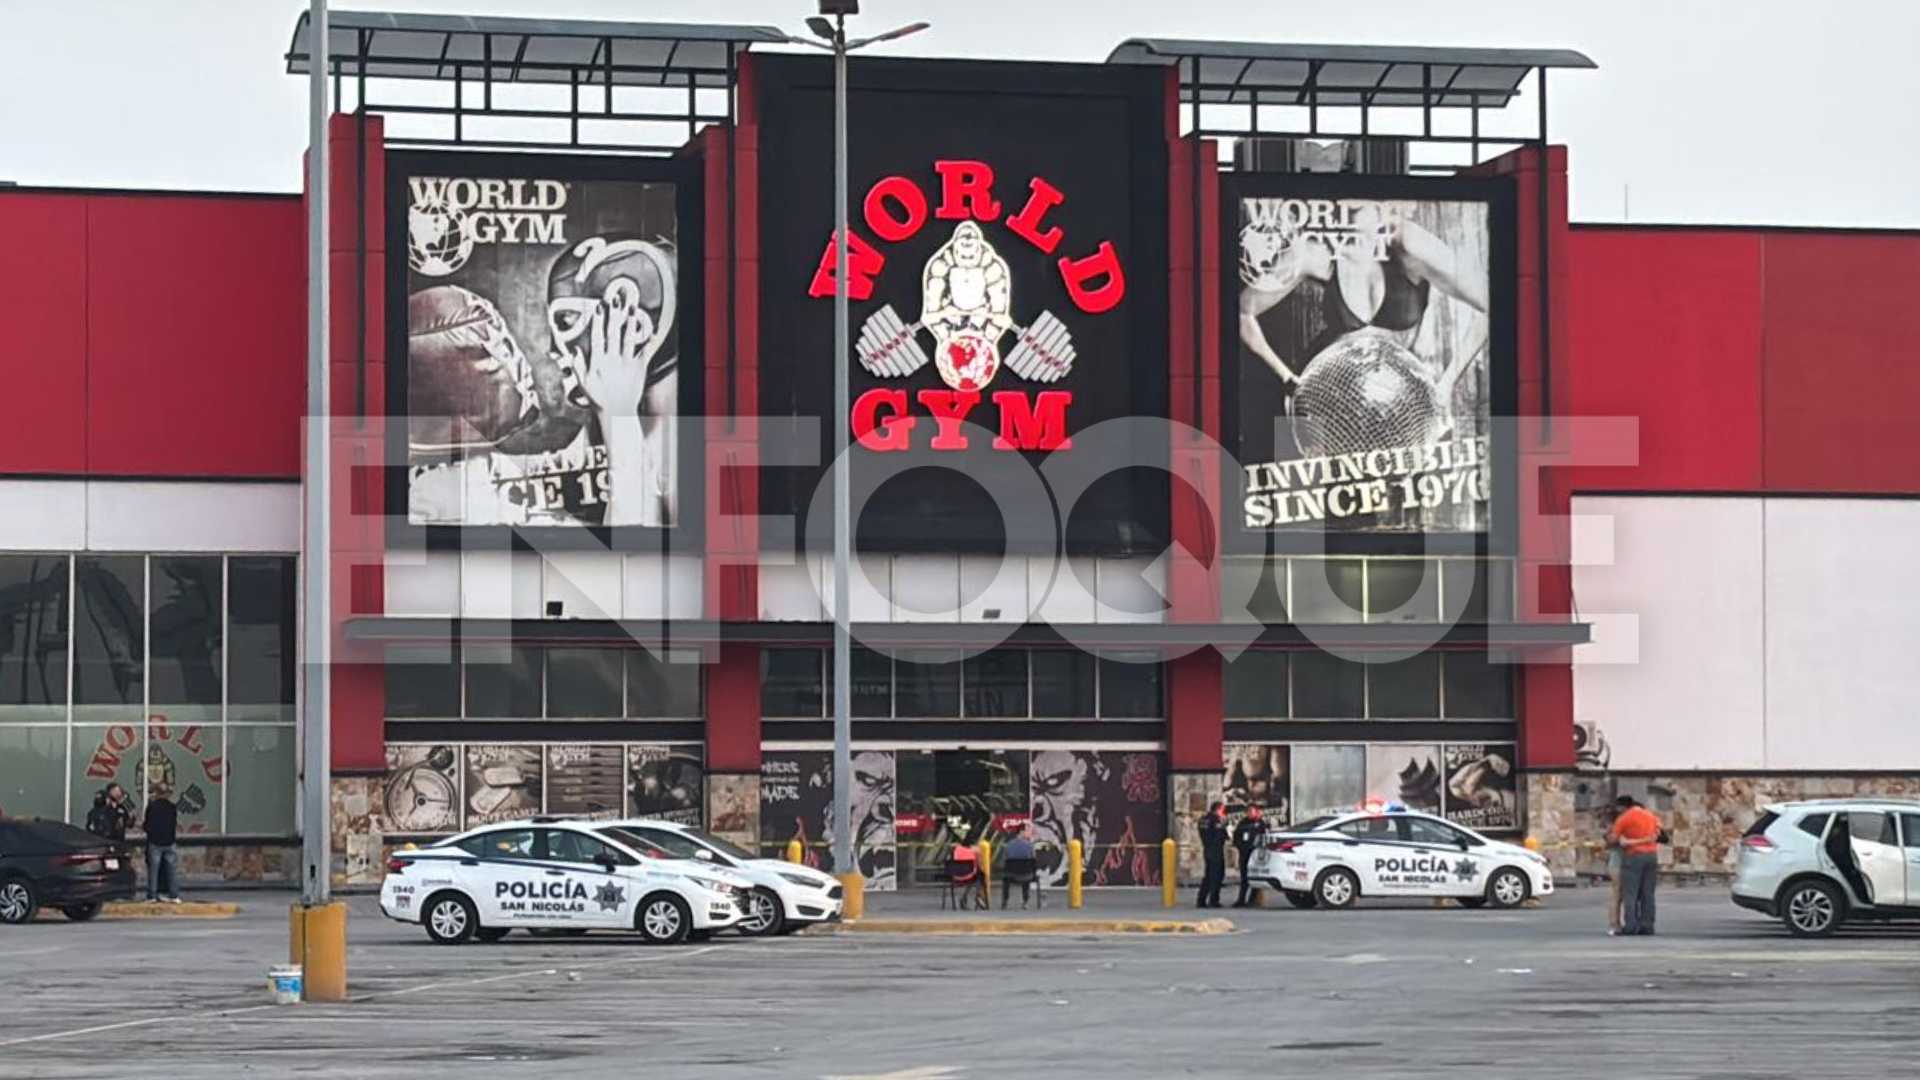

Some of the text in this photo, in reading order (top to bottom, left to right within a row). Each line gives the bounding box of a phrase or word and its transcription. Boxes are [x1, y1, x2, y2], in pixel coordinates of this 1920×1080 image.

[408, 176, 568, 210] WORLD
[467, 211, 568, 244] GYM
[1243, 198, 1386, 232] WORL
[808, 160, 1125, 313] WORLD
[851, 388, 1073, 452] GYM
[1244, 437, 1488, 493] INVINCIBLE
[1244, 479, 1390, 528] SINCE
[86, 714, 231, 784] WORLD
[1375, 856, 1449, 872] POLICÍA
[1379, 873, 1447, 883] SAN NICOLÁS
[495, 878, 588, 899] POLICÍA
[500, 900, 585, 912] SAN NICOLÁS
